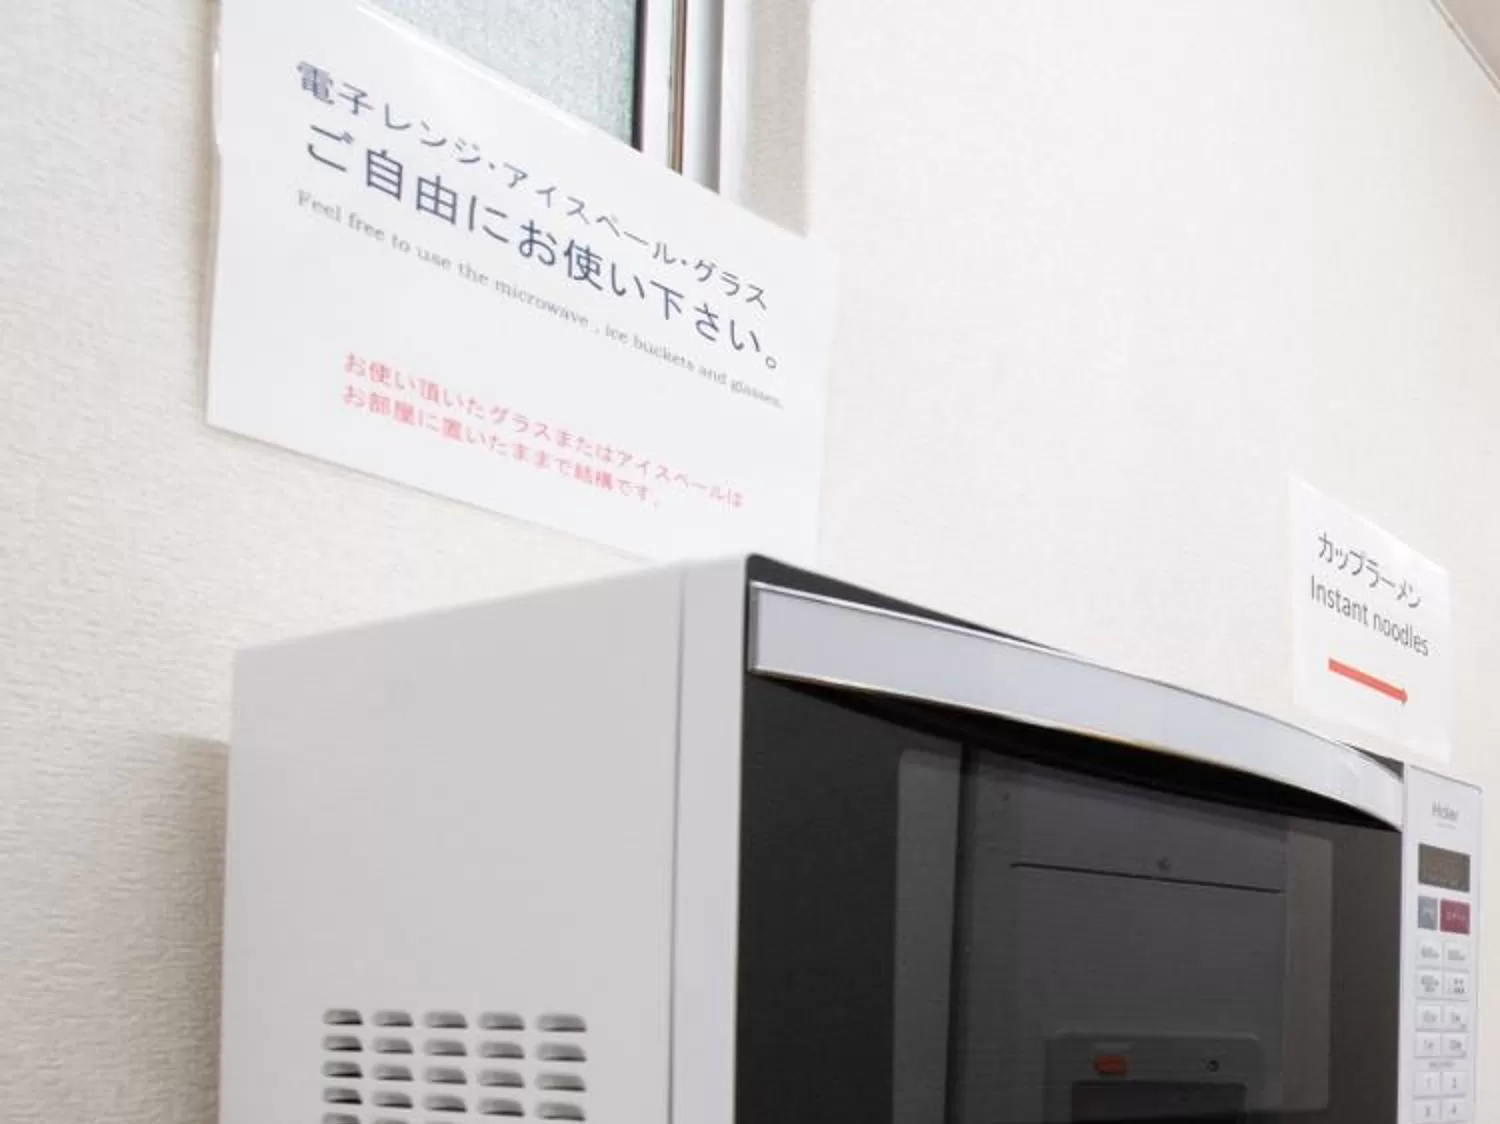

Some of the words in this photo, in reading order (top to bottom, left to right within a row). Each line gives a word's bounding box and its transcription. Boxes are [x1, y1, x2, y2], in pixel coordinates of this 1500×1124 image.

[297, 189, 342, 224] Feel
[348, 212, 386, 242] free
[391, 233, 412, 254] to
[416, 246, 453, 269] use
[458, 261, 489, 287] the
[494, 277, 589, 328] microwave
[605, 323, 630, 345] ice
[633, 335, 696, 373] buckets
[698, 362, 728, 387] and
[305, 123, 778, 369] ご自由にお使い下さい。
[1311, 574, 1369, 628] Instant
[1373, 610, 1430, 658] noodles
[1317, 530, 1423, 610] カップラーメン
